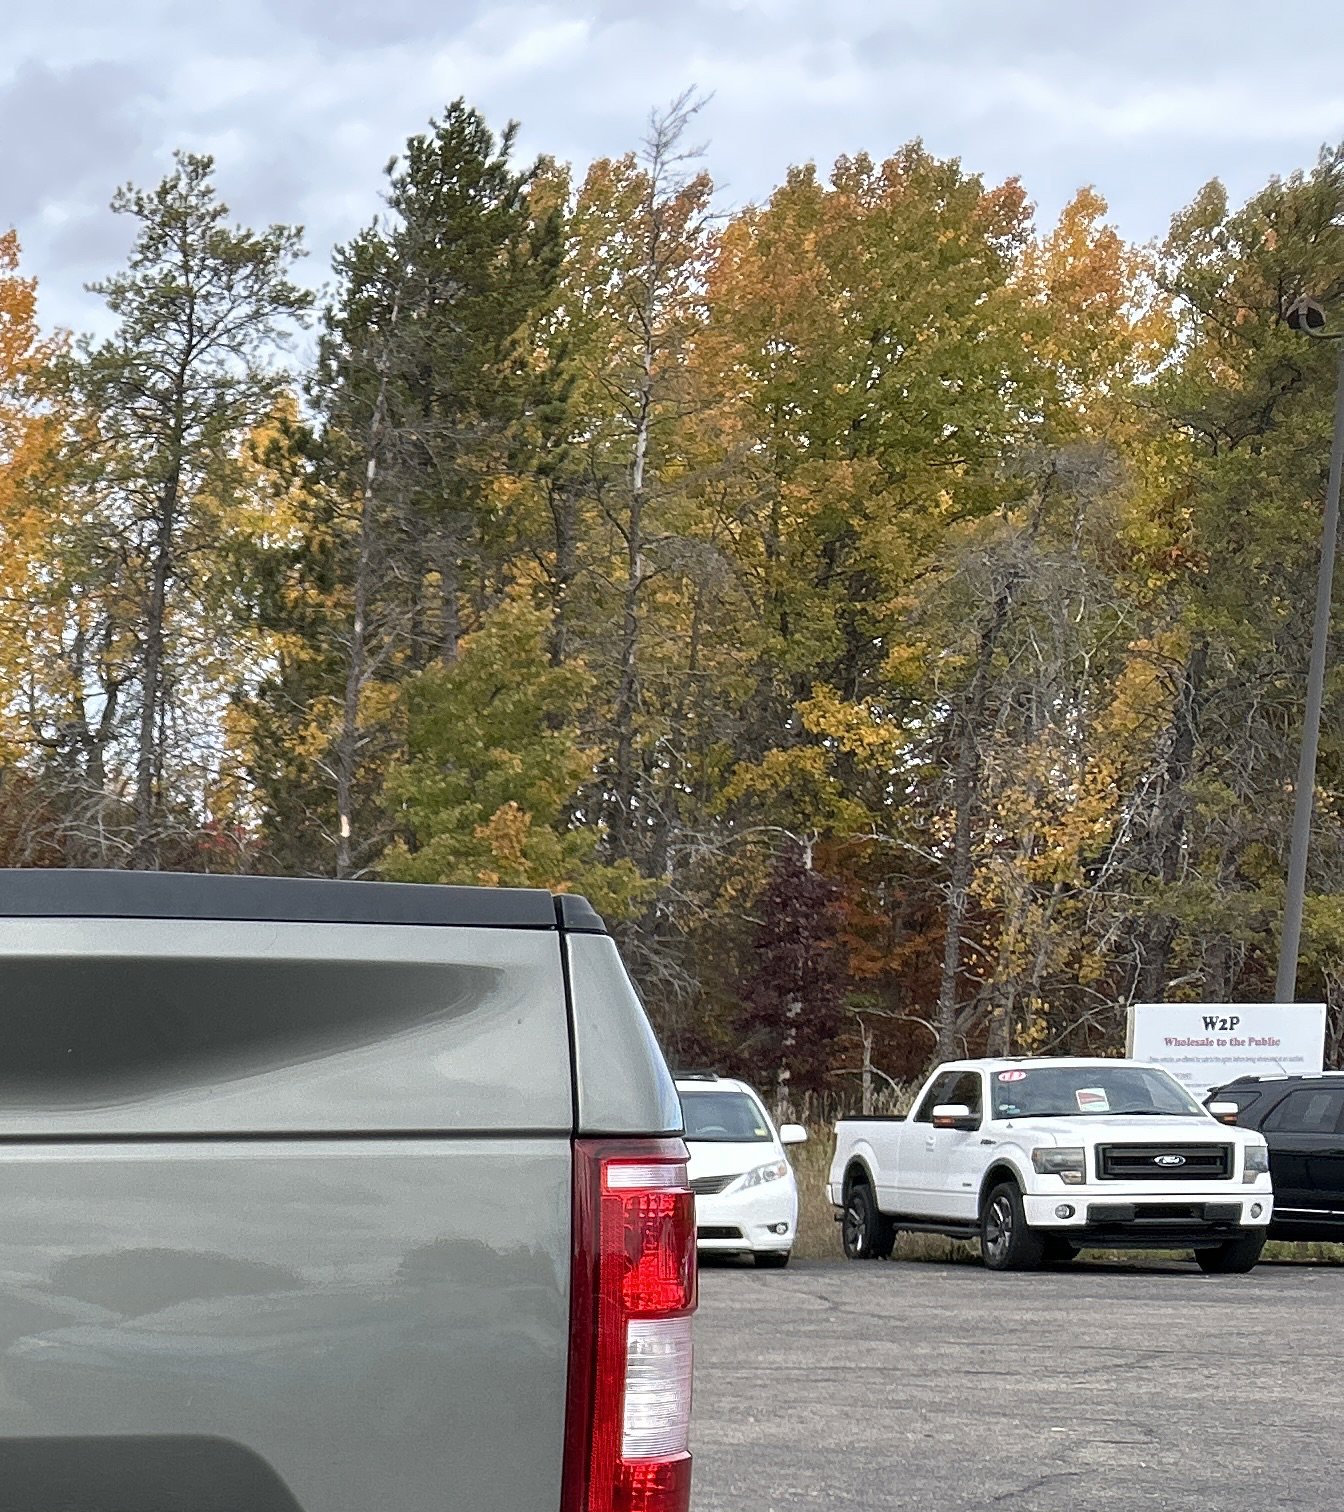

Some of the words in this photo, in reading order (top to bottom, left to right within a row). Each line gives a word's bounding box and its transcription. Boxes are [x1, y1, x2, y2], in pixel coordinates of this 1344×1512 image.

[1202, 1015, 1240, 1031] W2P
[1164, 1037, 1215, 1047] Wholesale
[1216, 1038, 1228, 1047] to
[1229, 1037, 1246, 1047] the
[1248, 1036, 1281, 1047] Public
